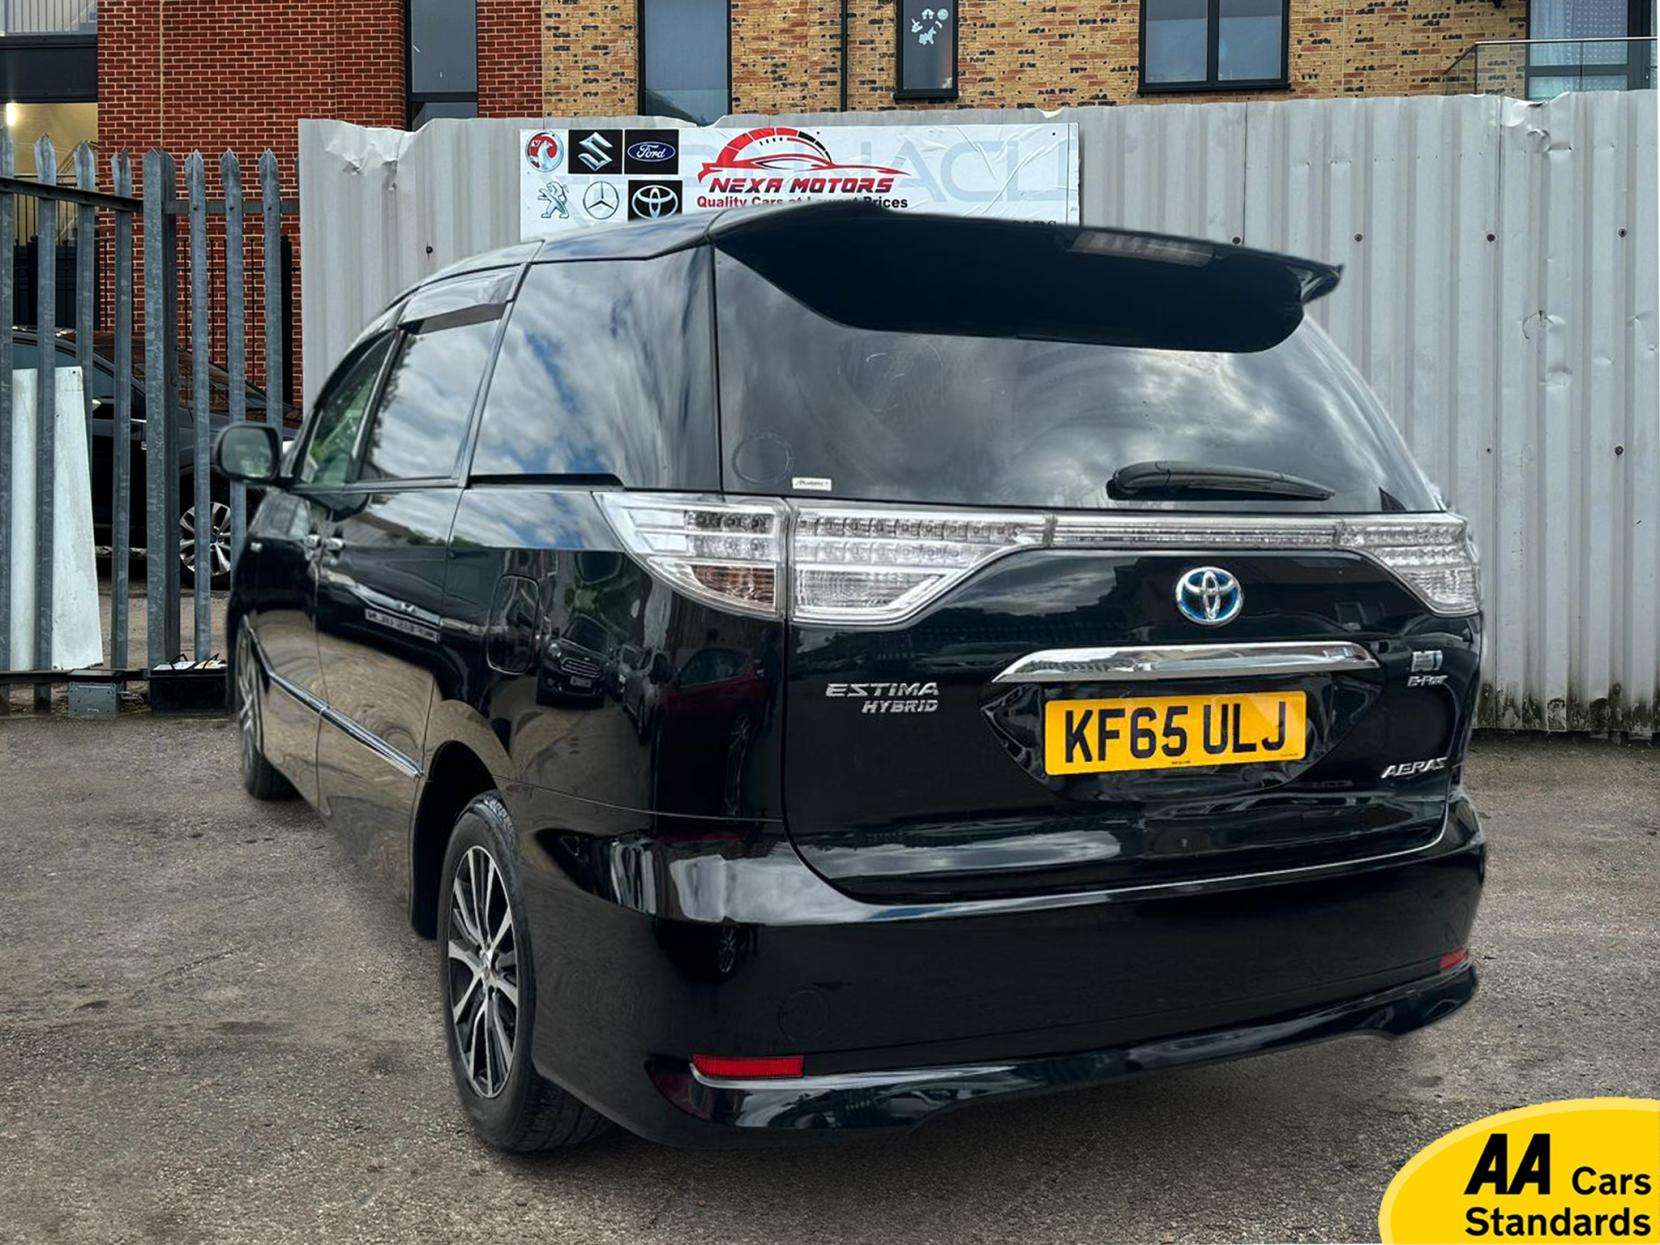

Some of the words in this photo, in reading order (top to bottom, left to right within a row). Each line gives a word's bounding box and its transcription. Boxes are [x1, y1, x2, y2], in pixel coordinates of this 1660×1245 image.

[636, 144, 666, 159] Ford
[708, 177, 783, 194] NEXA
[789, 177, 894, 194] MOTORS
[696, 195, 747, 208] Quality
[751, 196, 783, 207] Cars
[825, 682, 940, 697] ESTIMA
[861, 699, 939, 714] HYBRID
[1065, 705, 1188, 763] KF65
[1203, 701, 1287, 754] ULJ
[1381, 756, 1448, 779] AERAS
